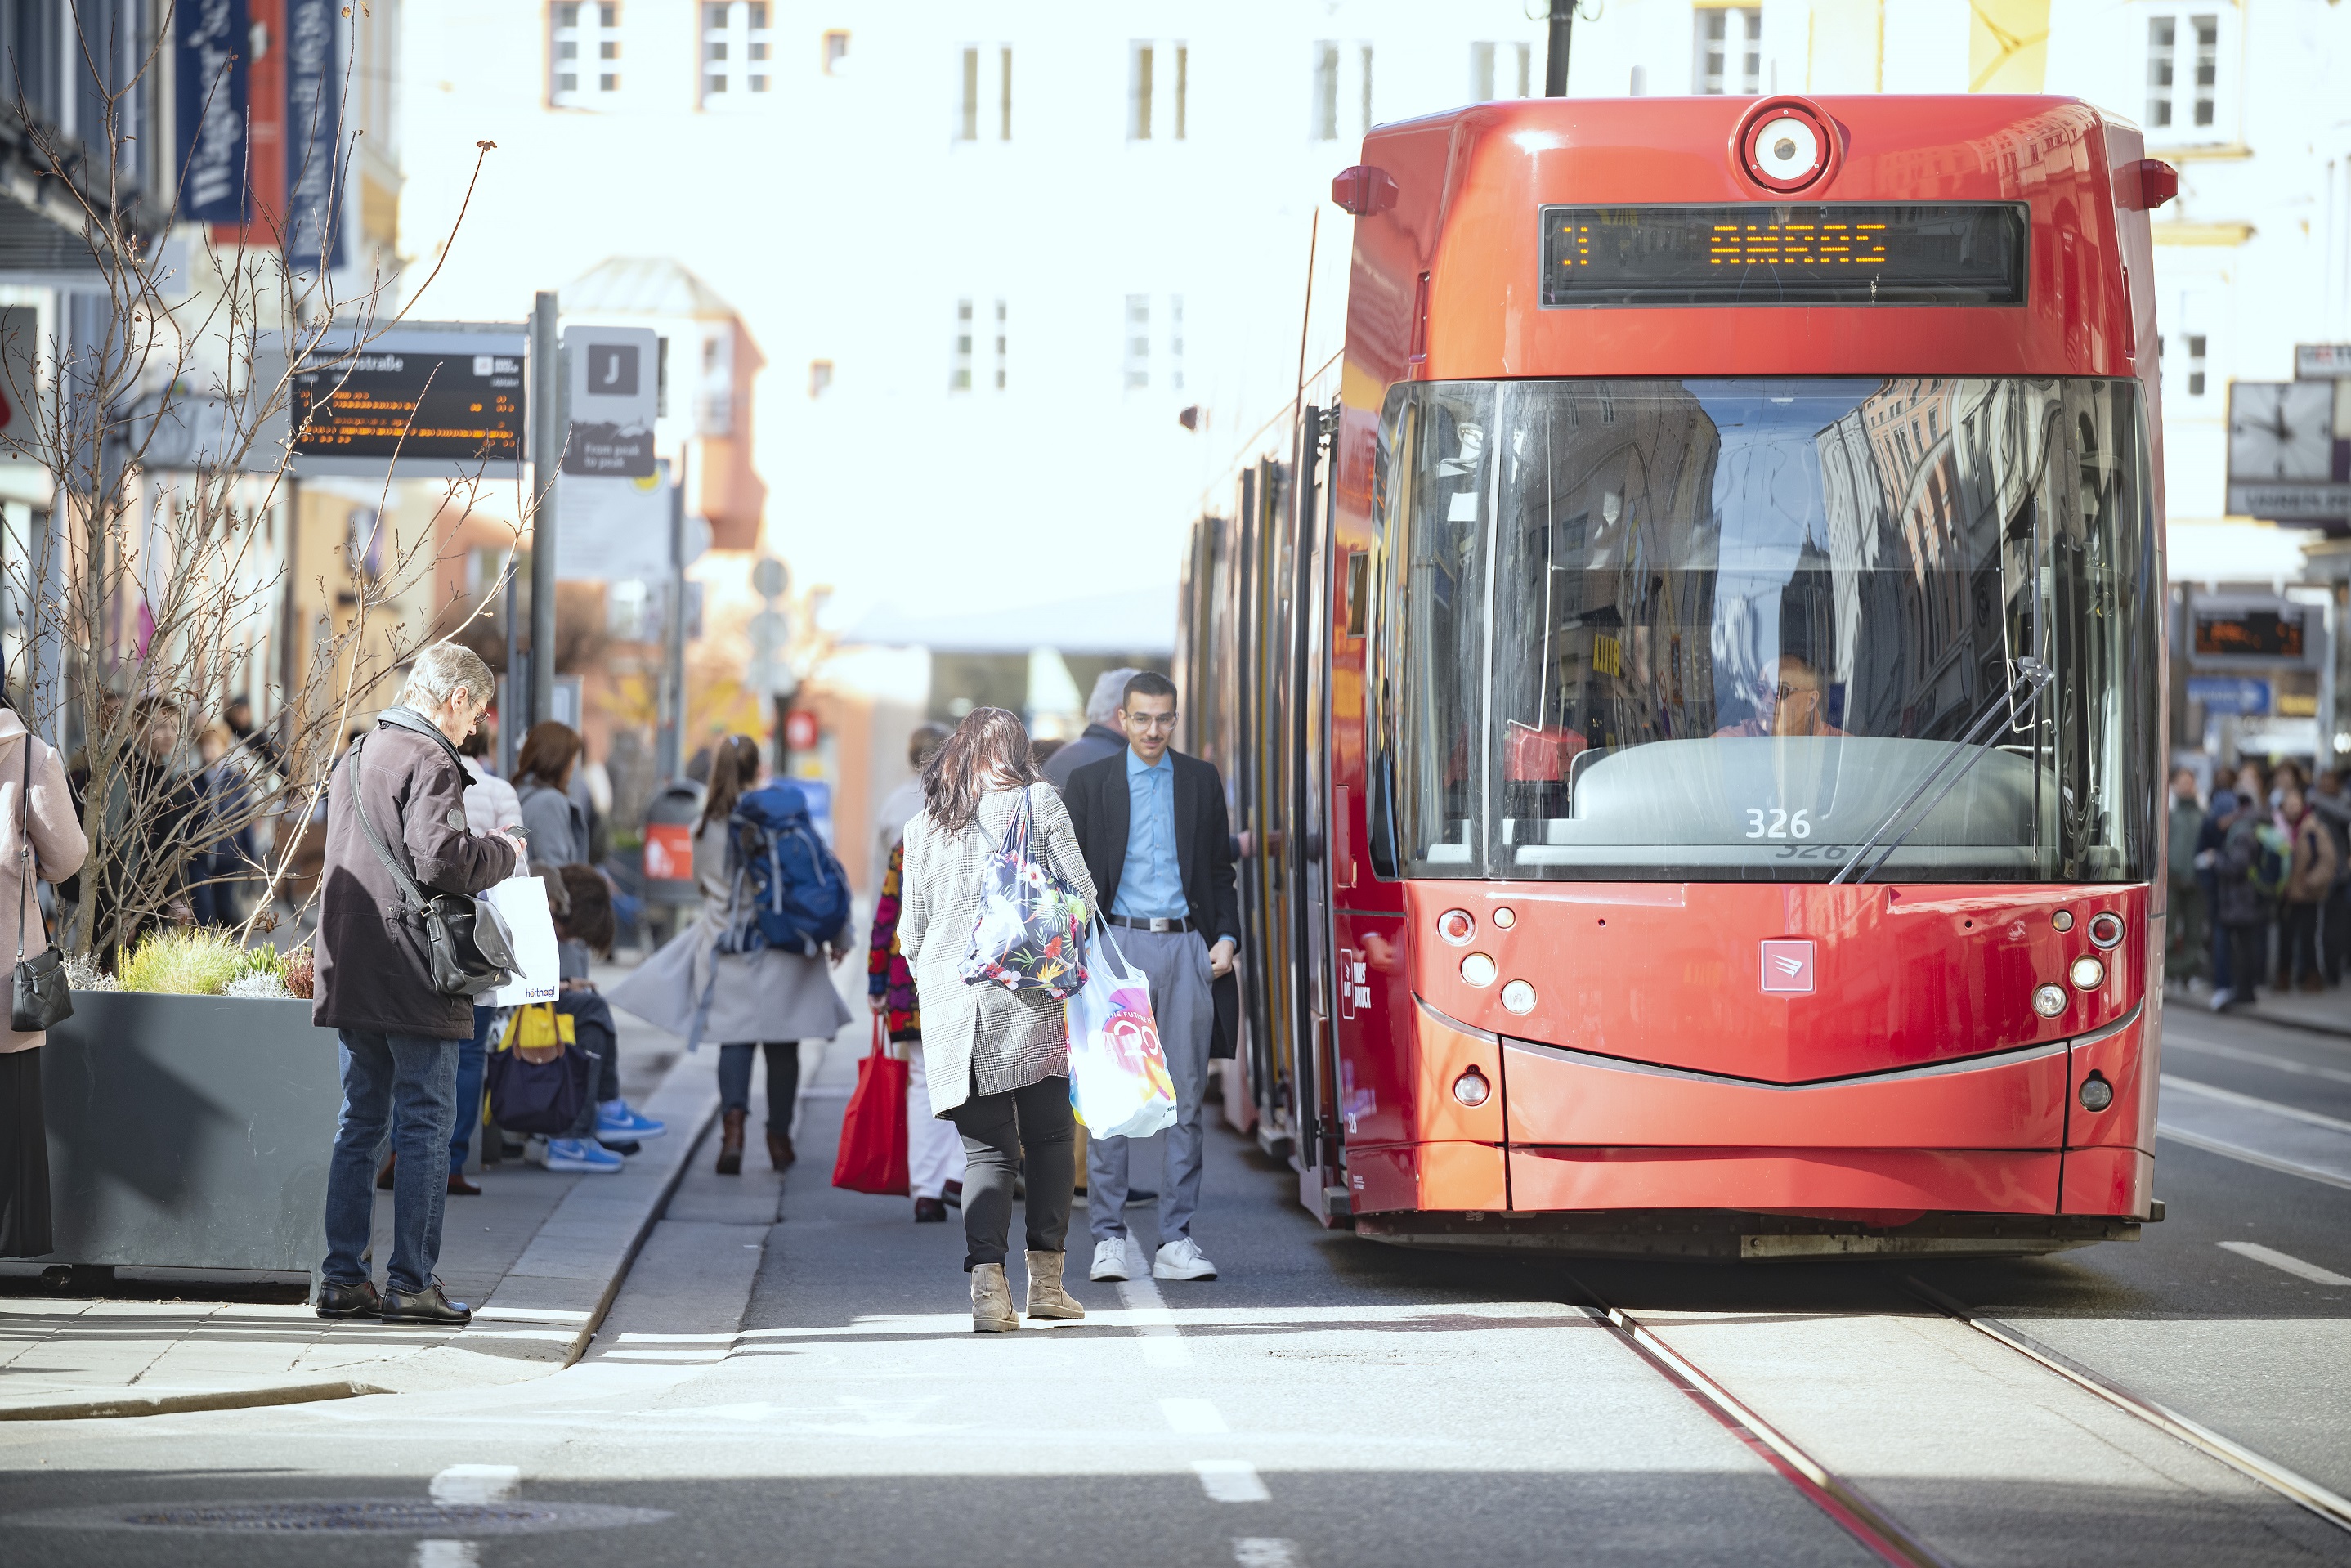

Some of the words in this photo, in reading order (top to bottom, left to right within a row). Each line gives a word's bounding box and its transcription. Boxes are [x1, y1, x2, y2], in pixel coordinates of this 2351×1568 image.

[603, 353, 620, 385] J
[1745, 808, 1811, 839] 326
[526, 986, 555, 997] hörtnagl
[1355, 986, 1371, 1009] BRUCK
[1106, 1011, 1122, 1019] THE
[1123, 1011, 1147, 1023] FUTURE
[1348, 1112, 1357, 1134] 326
